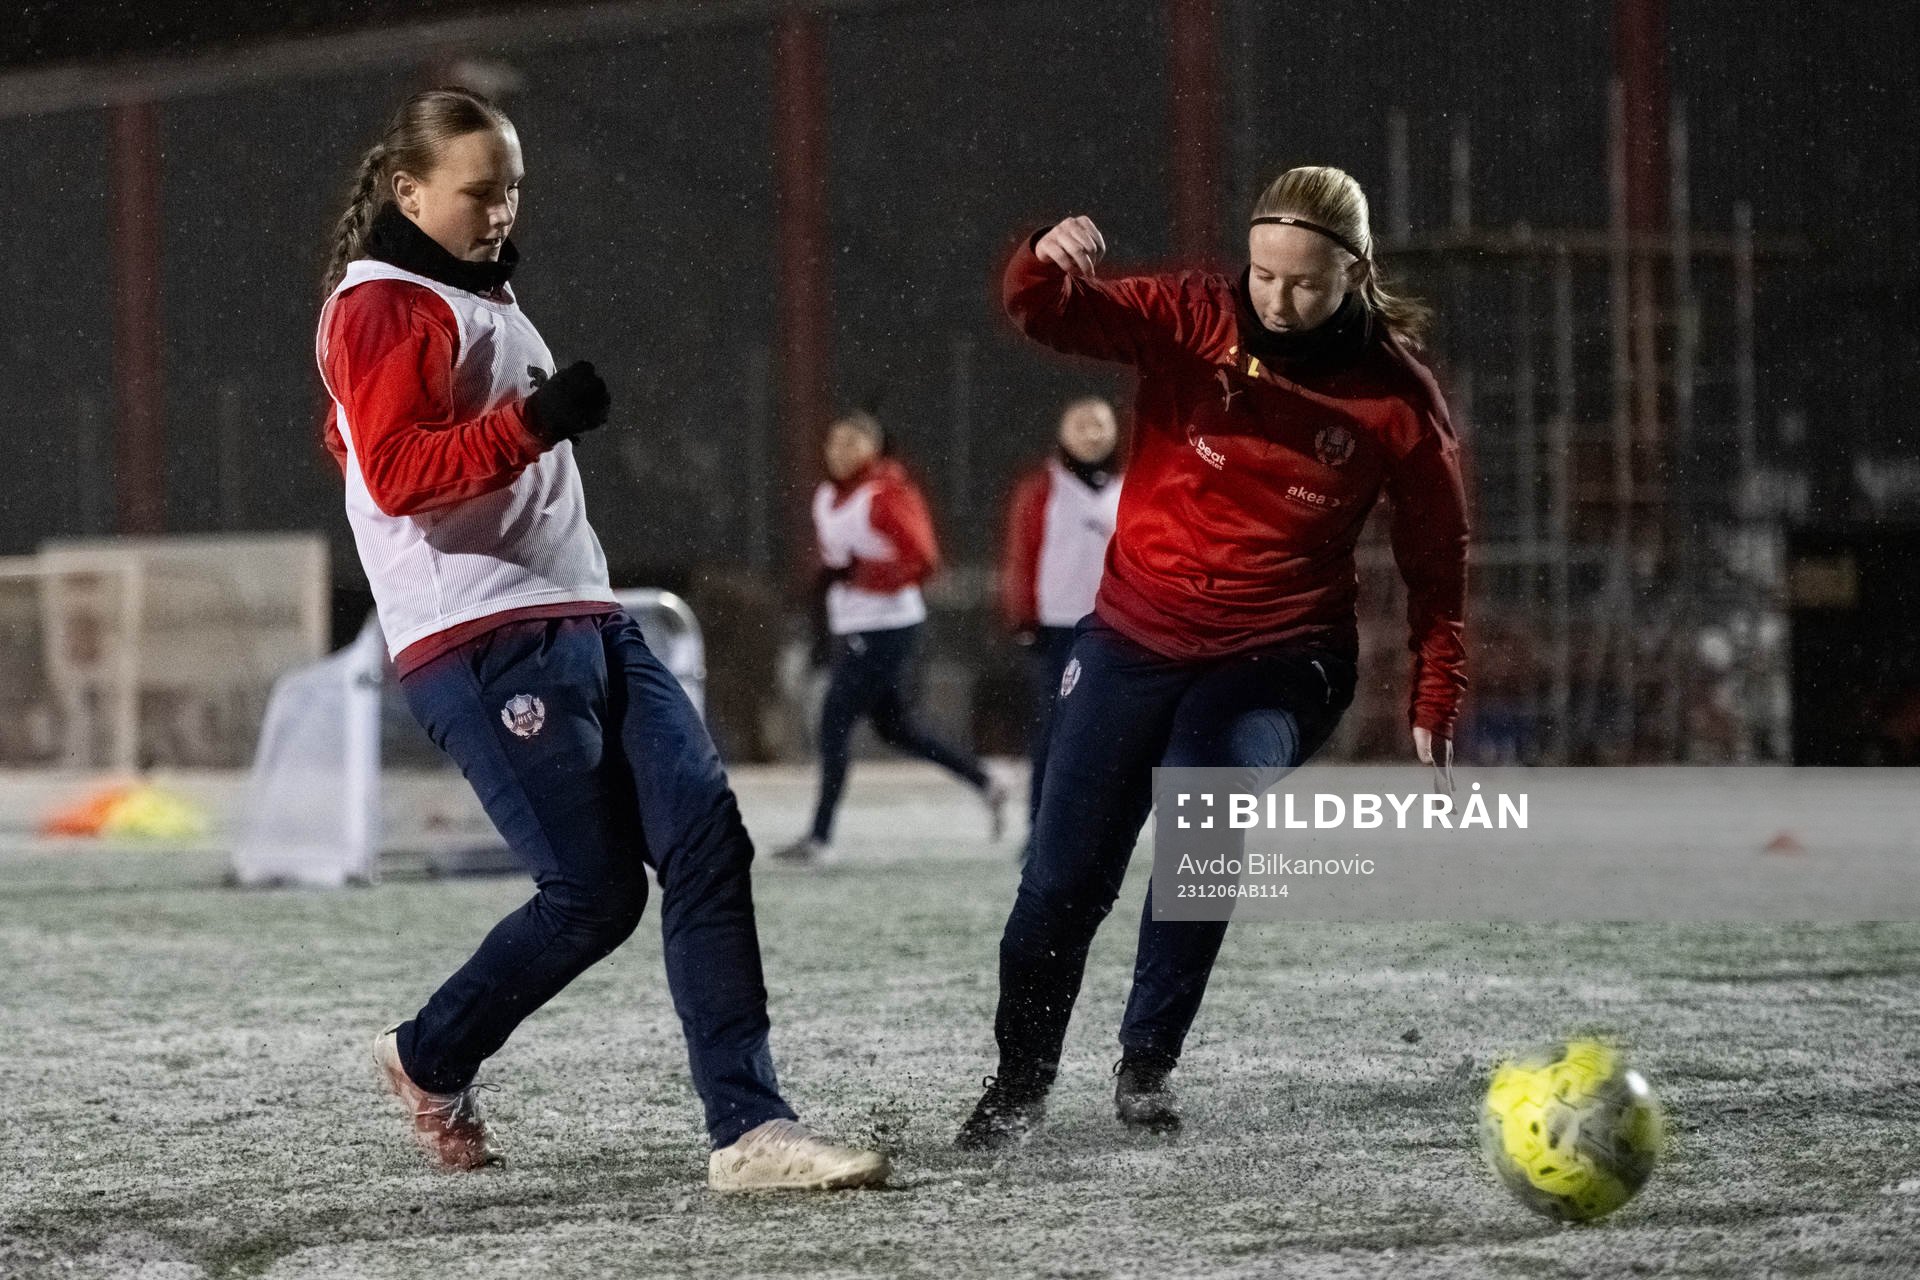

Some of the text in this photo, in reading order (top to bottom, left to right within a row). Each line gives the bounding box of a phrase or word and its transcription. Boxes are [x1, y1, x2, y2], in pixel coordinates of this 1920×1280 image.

[1197, 437, 1227, 466] beat
[1287, 486, 1326, 505] akea
[518, 712, 533, 725] HIF
